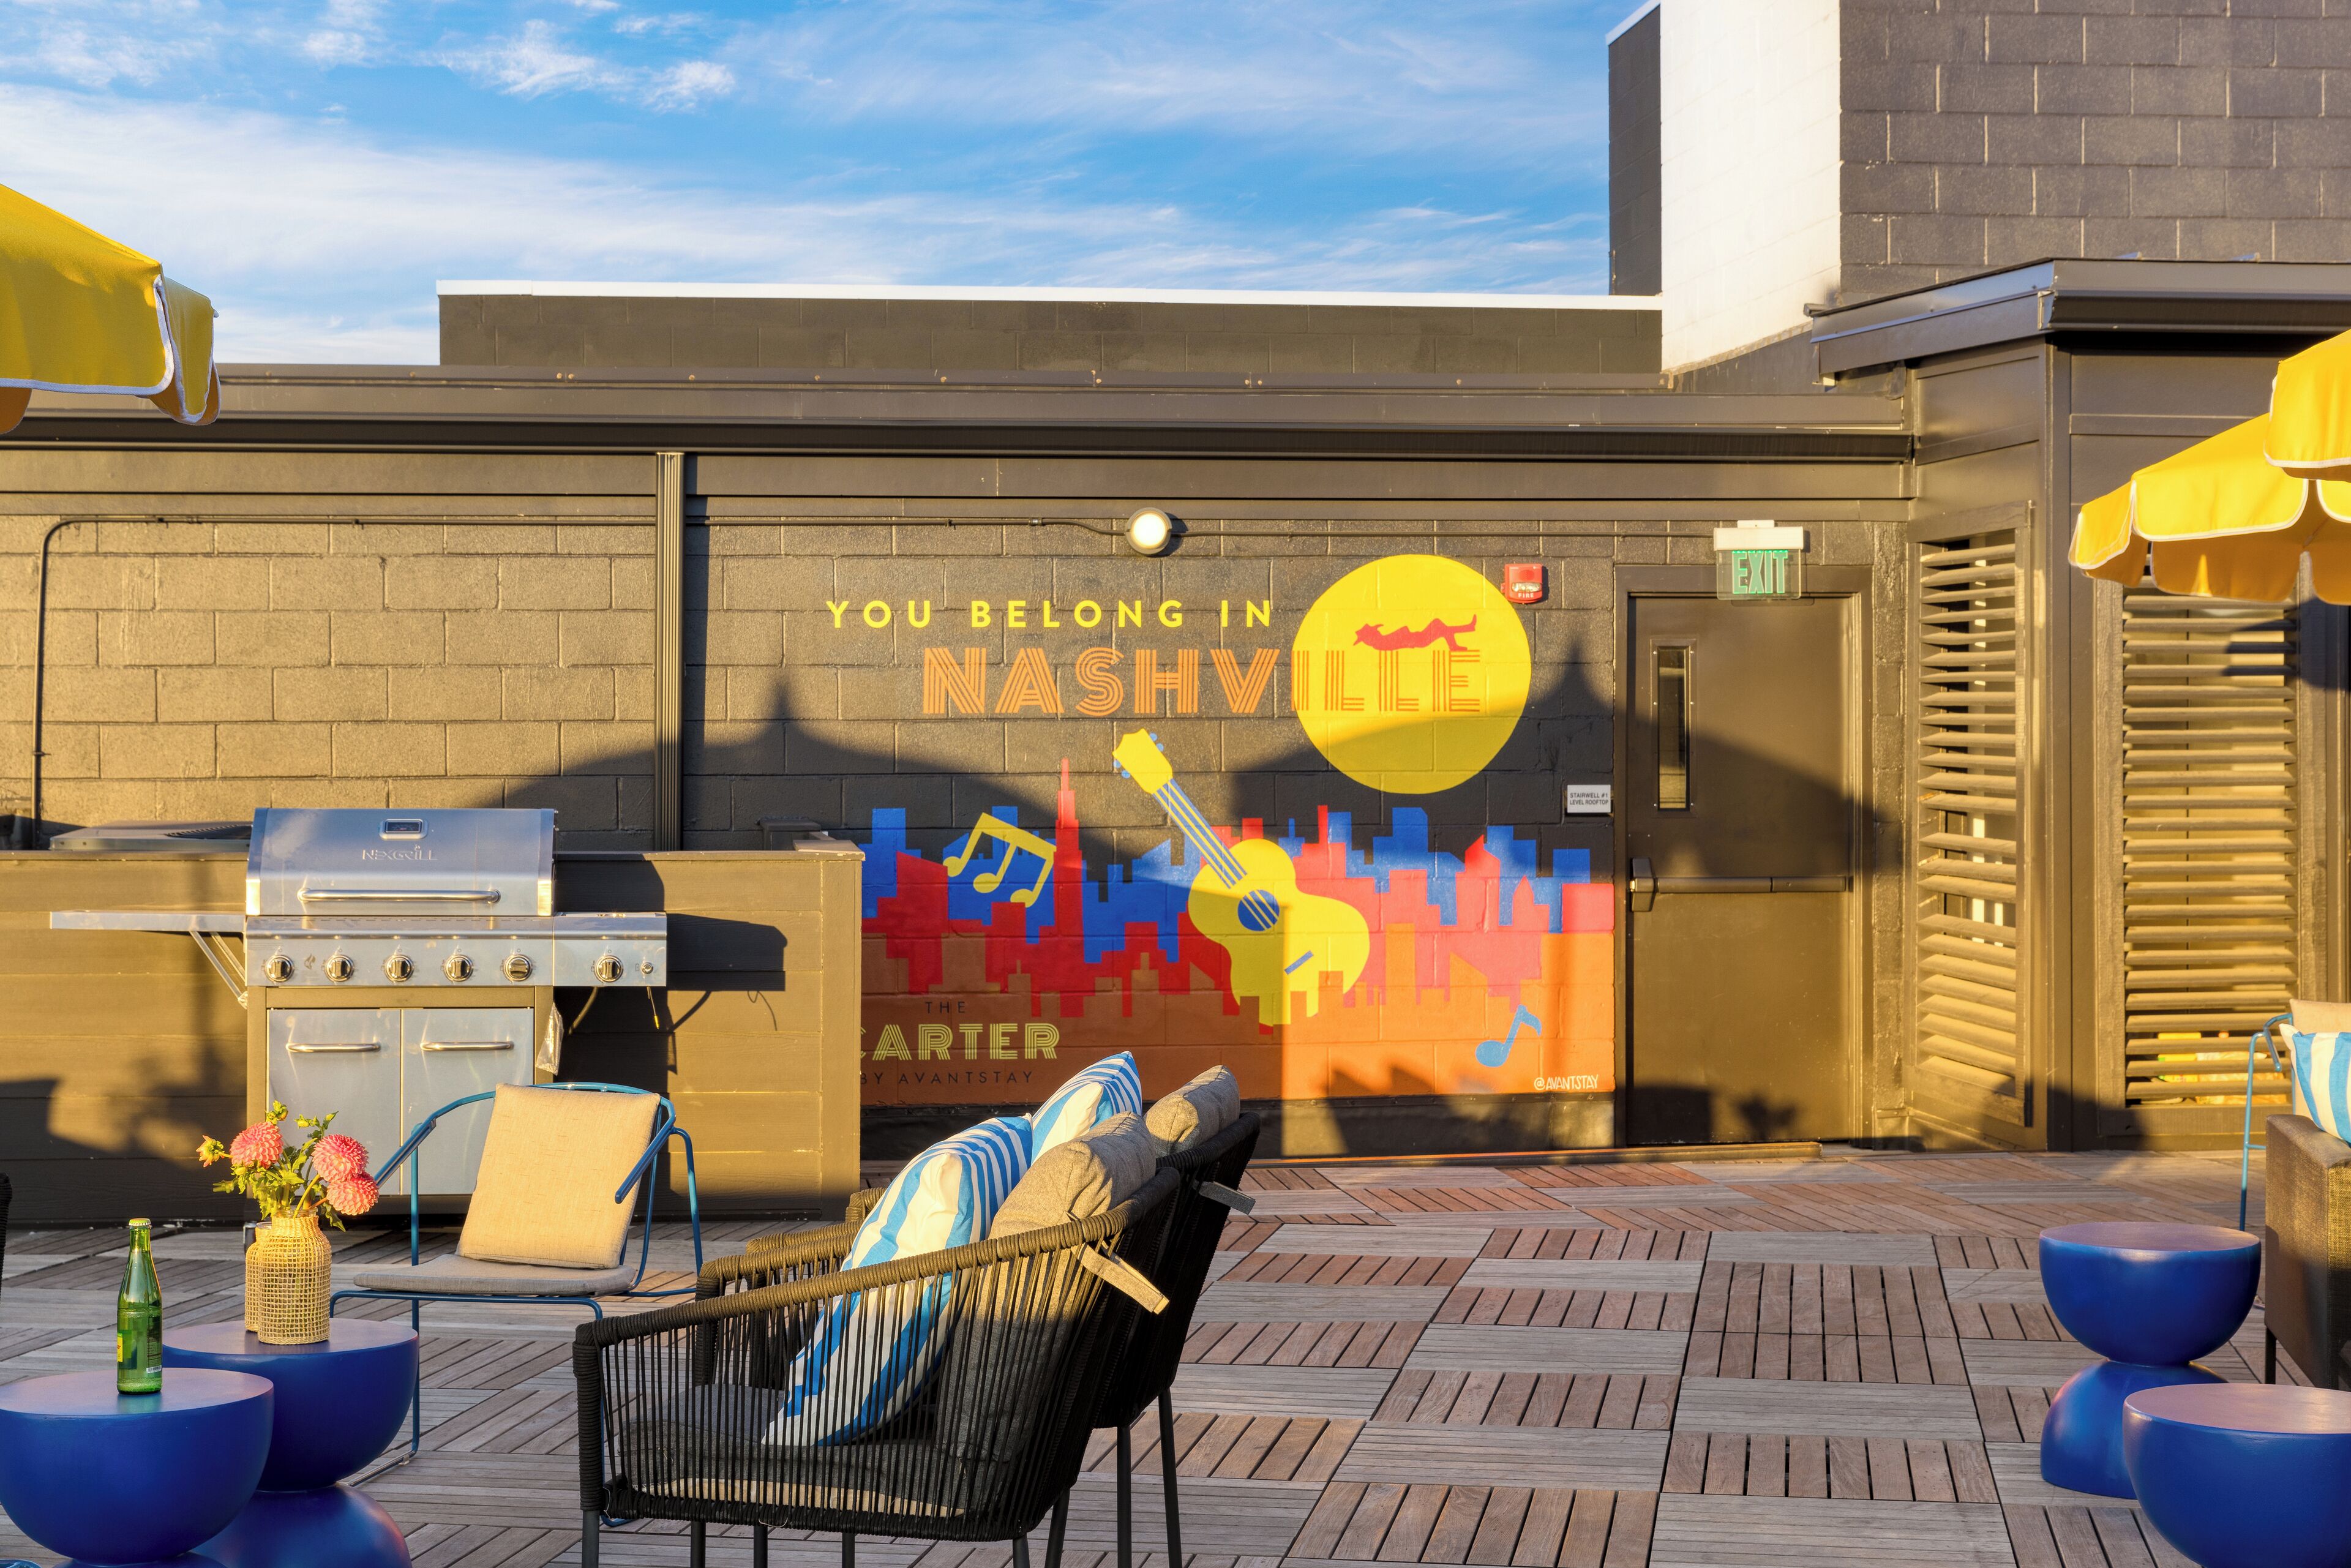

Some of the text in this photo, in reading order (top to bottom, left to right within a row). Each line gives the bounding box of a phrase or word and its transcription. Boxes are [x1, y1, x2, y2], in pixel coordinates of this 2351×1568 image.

[1731, 550, 1788, 595] EXIT
[826, 599, 1272, 628] YOU BELONG IN
[921, 647, 1482, 716] NASHVILLE
[362, 844, 438, 860] NEXGRILL
[924, 1001, 966, 1014] THE
[860, 1023, 1060, 1061] ARTER
[898, 1071, 1033, 1084] AVANTSTAY
[1534, 1075, 1599, 1090] @AVANTSTAY
